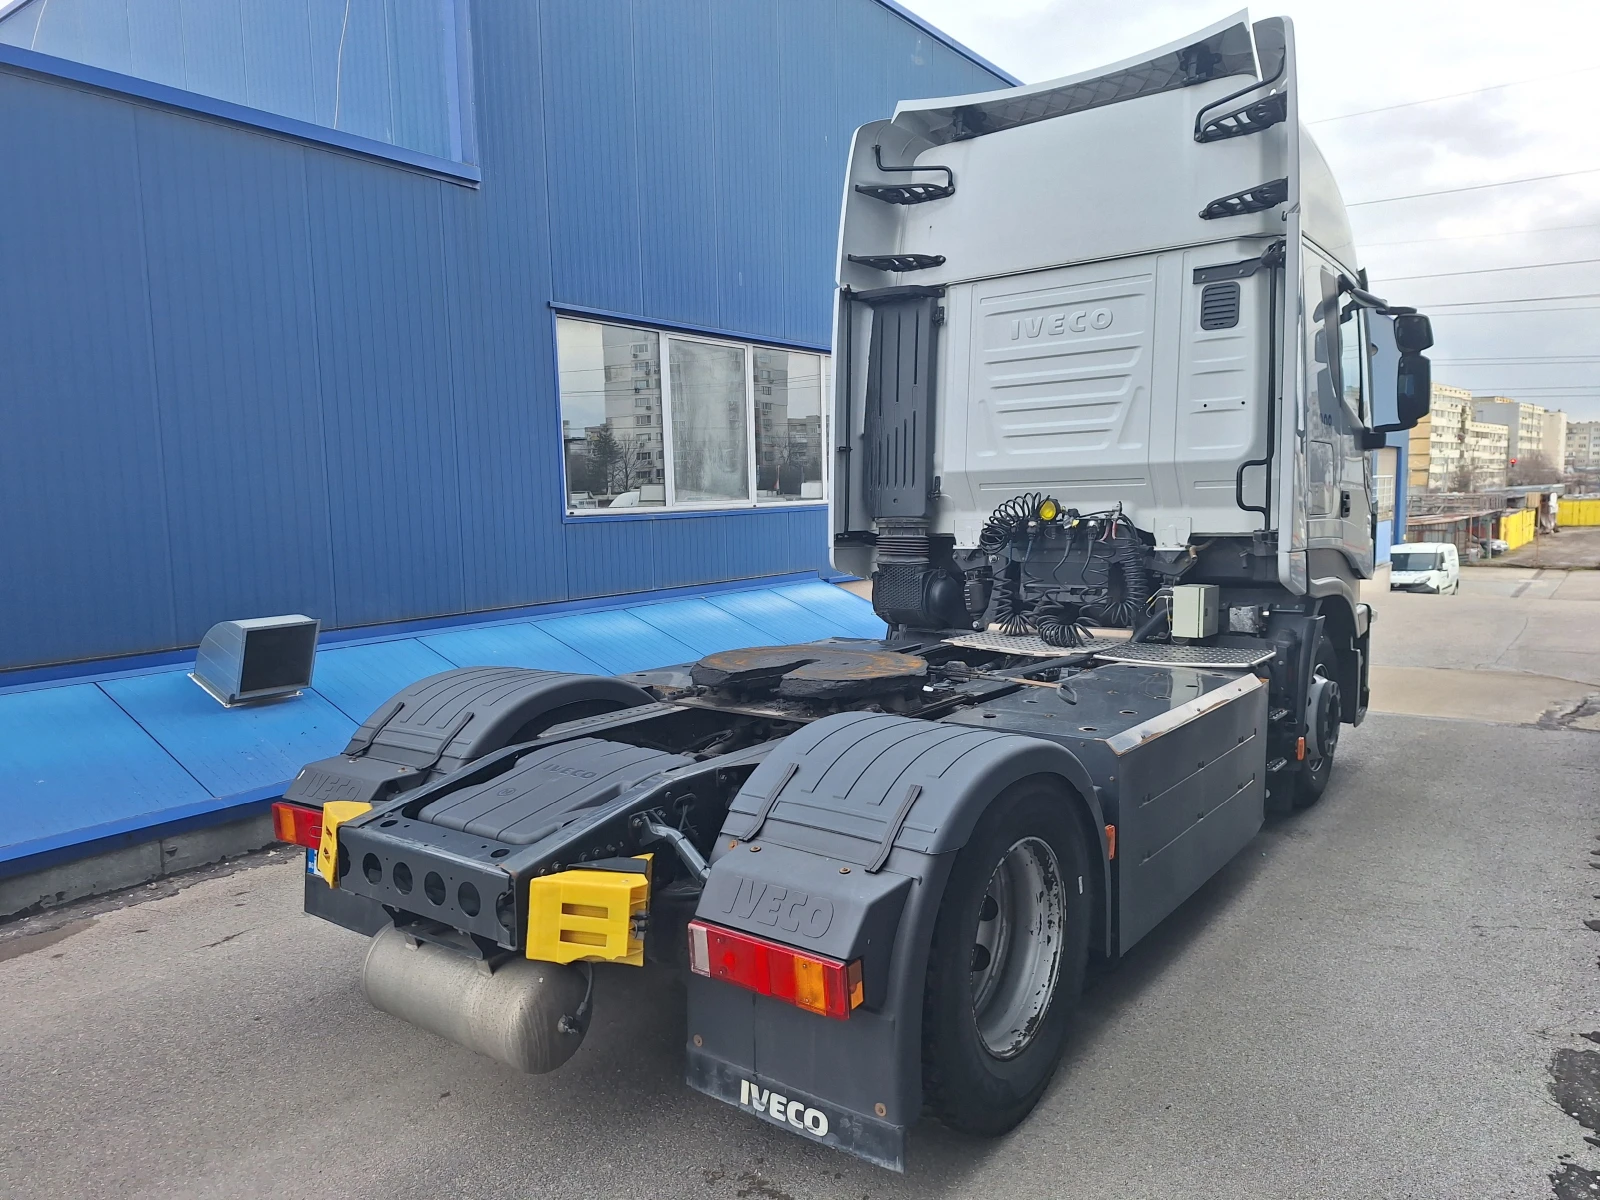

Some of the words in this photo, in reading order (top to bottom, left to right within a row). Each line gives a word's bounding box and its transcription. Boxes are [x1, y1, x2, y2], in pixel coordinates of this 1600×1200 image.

[1011, 308, 1113, 341] IVECO
[542, 764, 598, 779] IVECO
[721, 875, 835, 939] IVECO
[740, 1079, 829, 1137] IVECO
